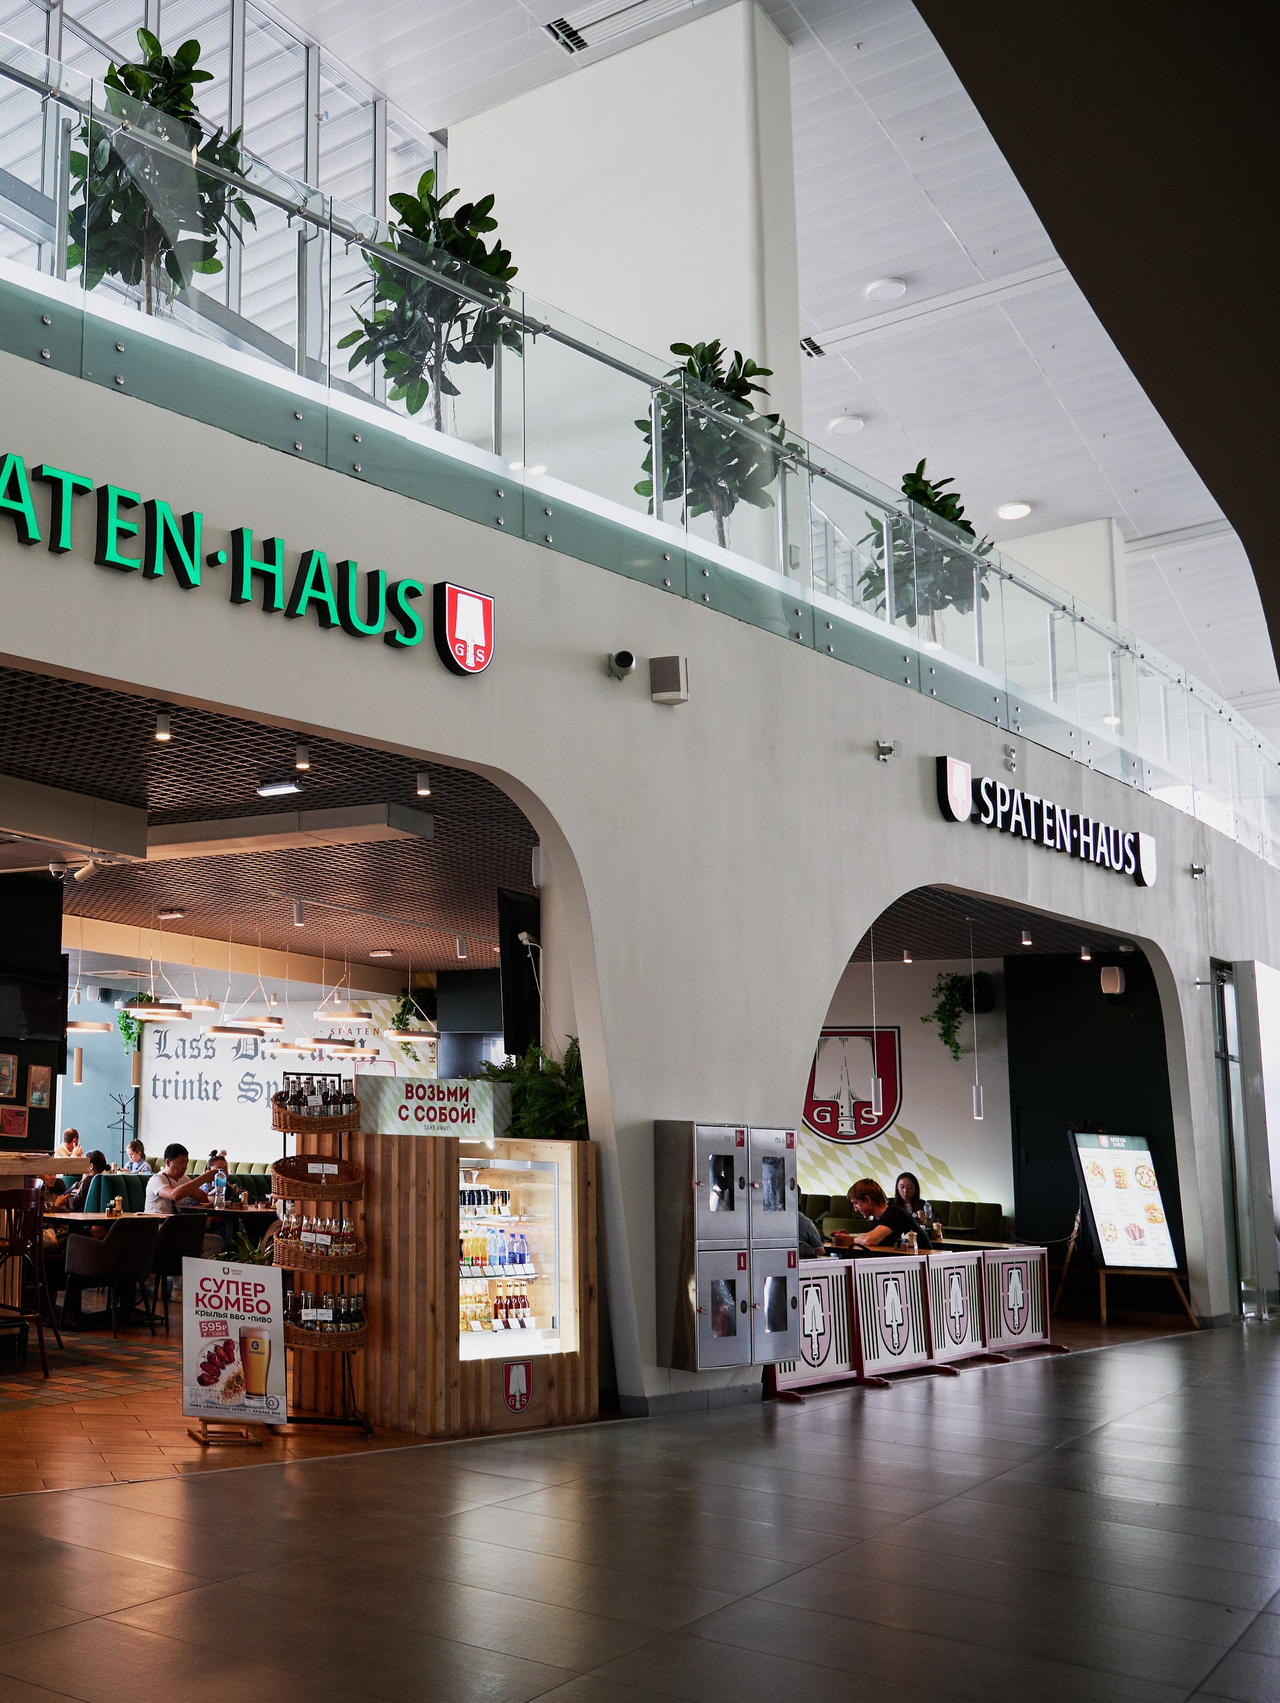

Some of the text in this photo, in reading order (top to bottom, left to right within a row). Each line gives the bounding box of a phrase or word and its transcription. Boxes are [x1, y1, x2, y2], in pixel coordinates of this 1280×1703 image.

[455, 643, 485, 663] G S
[152, 1029, 216, 1061] Lass
[151, 1071, 223, 1101] trinke
[405, 1083, 469, 1102] ВОЗЬМИ
[398, 1103, 476, 1124] С СОБОЙ!
[813, 1106, 879, 1125] G S
[200, 1277, 265, 1297] СУПЕР
[195, 1292, 271, 1315] КОМБО
